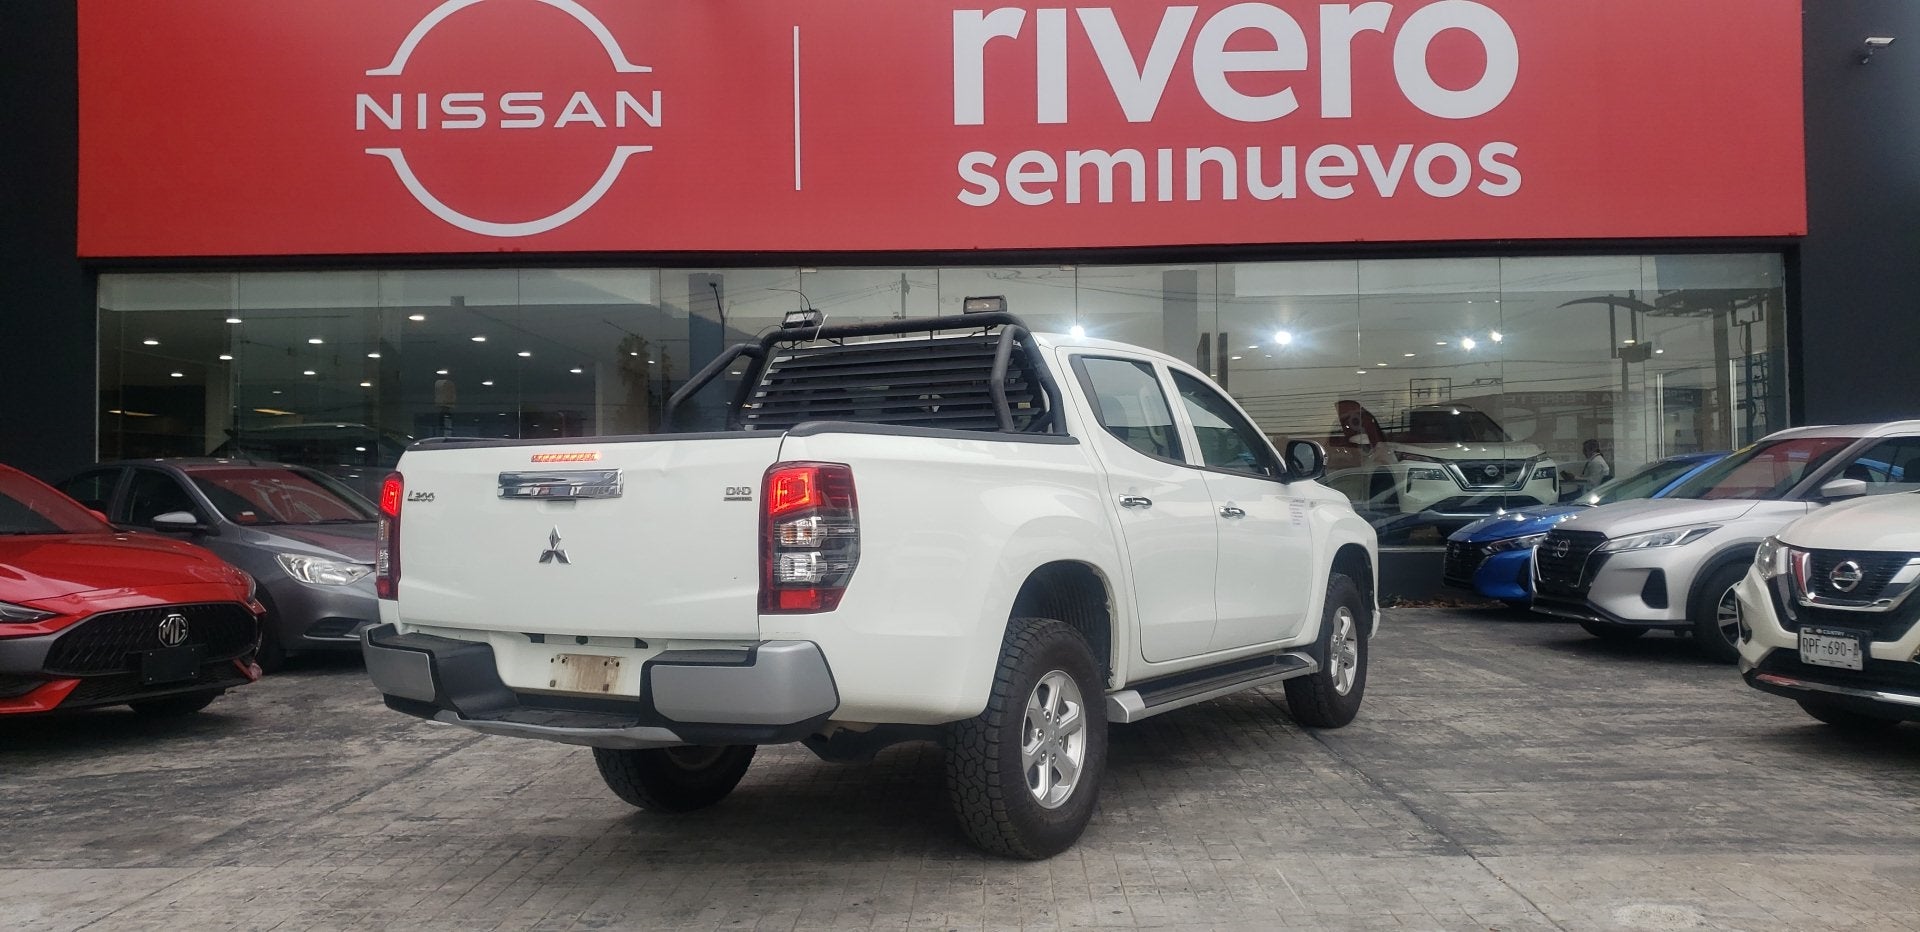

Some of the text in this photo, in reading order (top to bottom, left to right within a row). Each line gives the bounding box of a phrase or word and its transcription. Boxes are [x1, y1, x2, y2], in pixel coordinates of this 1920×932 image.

[953, 0, 1520, 125] rivero
[356, 91, 662, 130] NISSAN
[957, 141, 1522, 207] seminuevos
[407, 490, 435, 503] L300
[162, 617, 187, 645] MG
